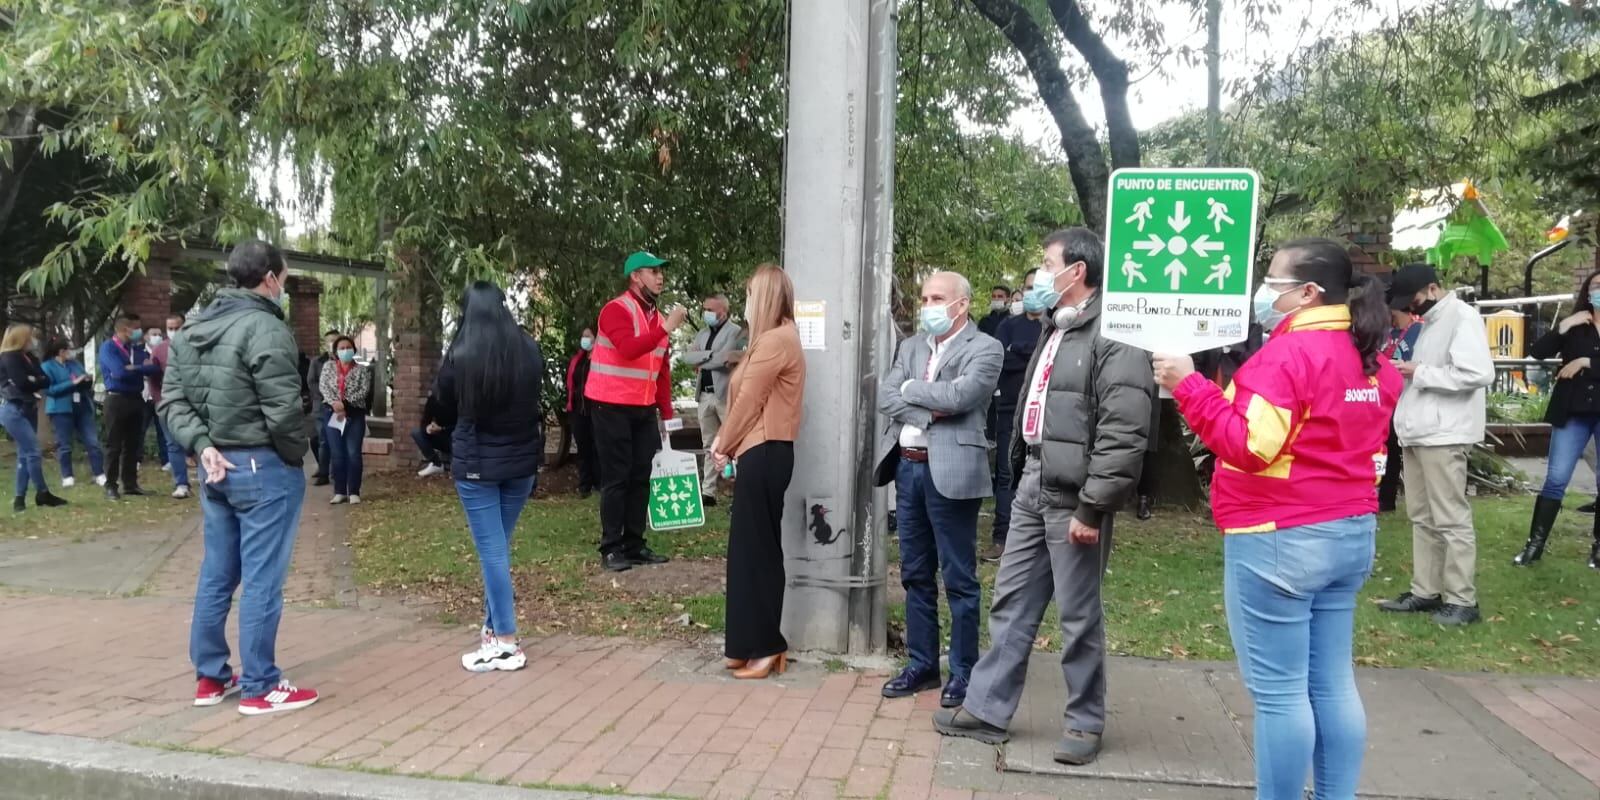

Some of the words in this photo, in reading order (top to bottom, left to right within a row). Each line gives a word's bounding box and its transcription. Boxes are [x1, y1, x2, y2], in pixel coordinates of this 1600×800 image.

[1117, 178, 1156, 190] PUNTO
[1157, 179, 1172, 190] DE
[1175, 179, 1249, 191] ENCUENTRO
[1107, 303, 1136, 312] GRUPO:
[1137, 297, 1171, 315] PUNTO
[1176, 298, 1242, 318] ENCUENTRO
